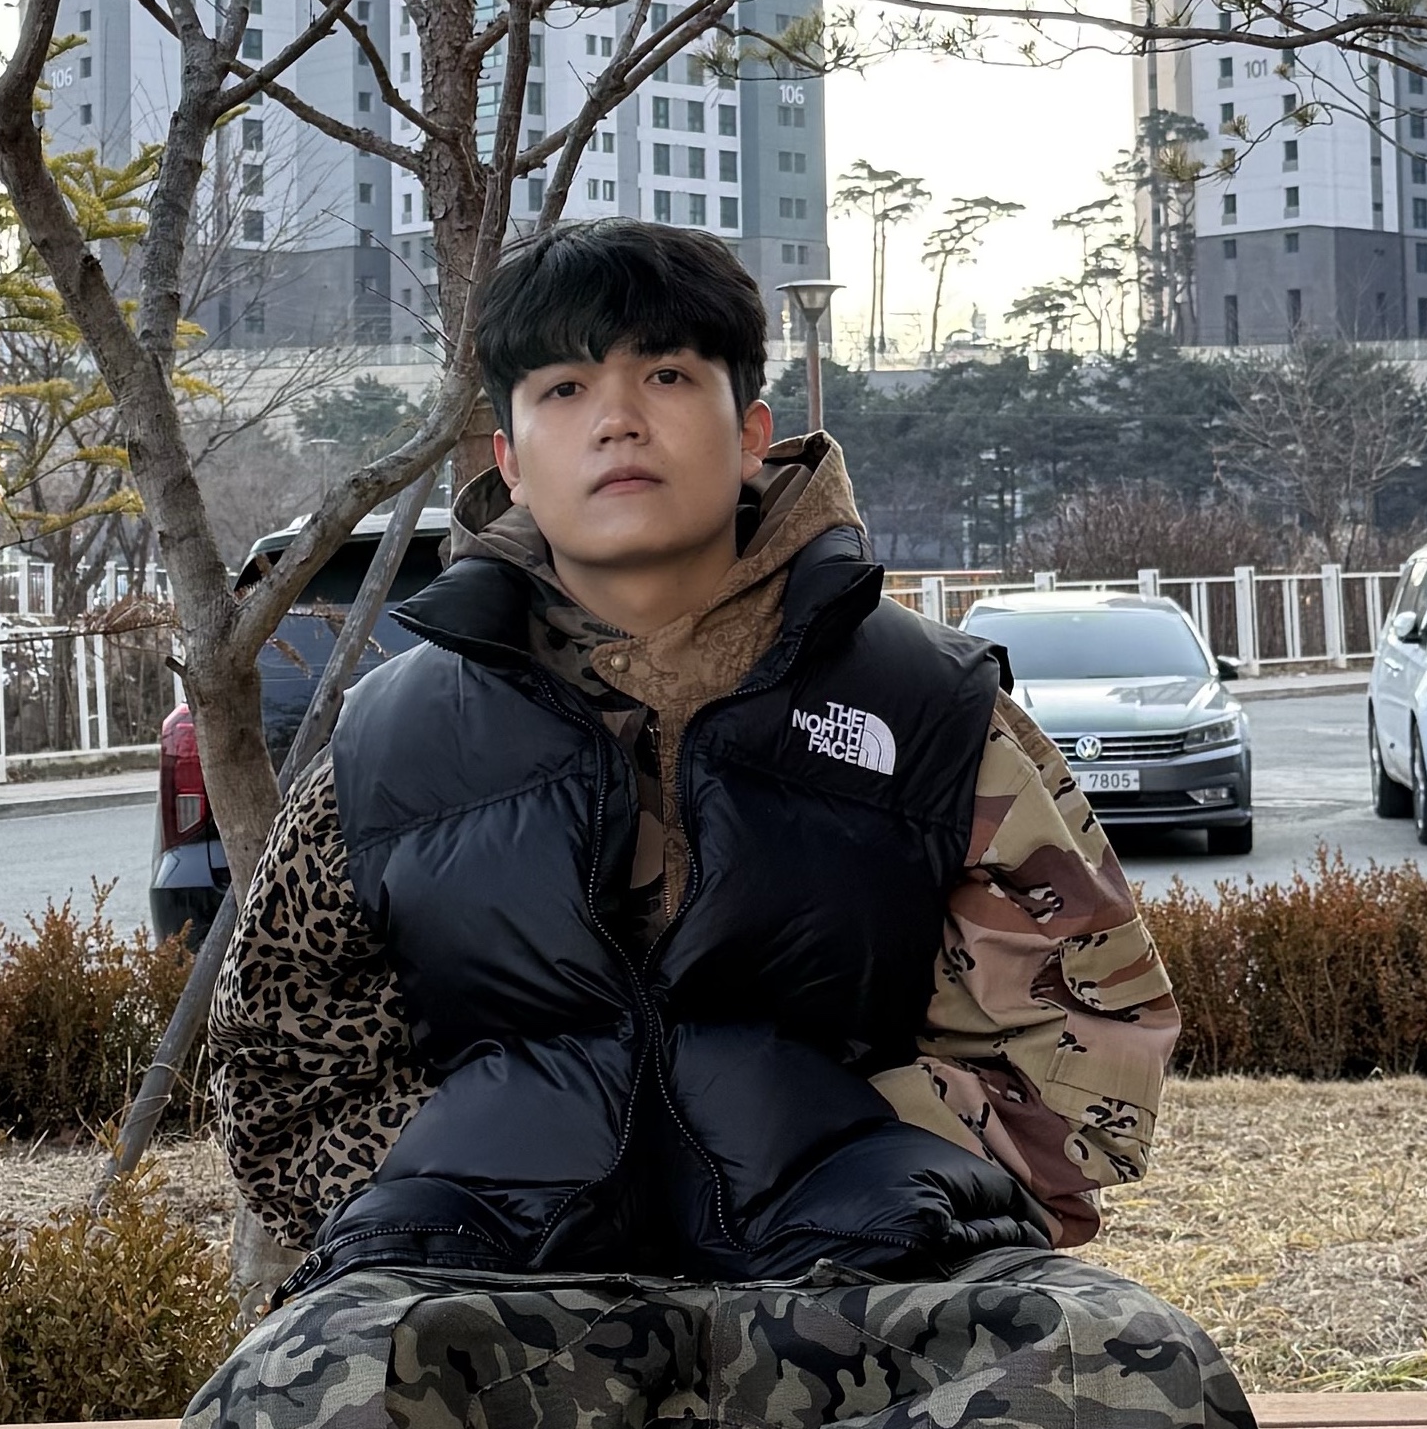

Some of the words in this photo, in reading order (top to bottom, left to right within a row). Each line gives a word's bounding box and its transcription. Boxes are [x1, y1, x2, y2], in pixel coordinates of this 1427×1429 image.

[51, 67, 72, 89] 106
[1244, 58, 1267, 79] 101
[779, 84, 804, 104] 106
[826, 701, 866, 726] THE
[792, 708, 863, 746] NORTH
[808, 733, 860, 764] FACE
[1089, 773, 1131, 788] 7805
